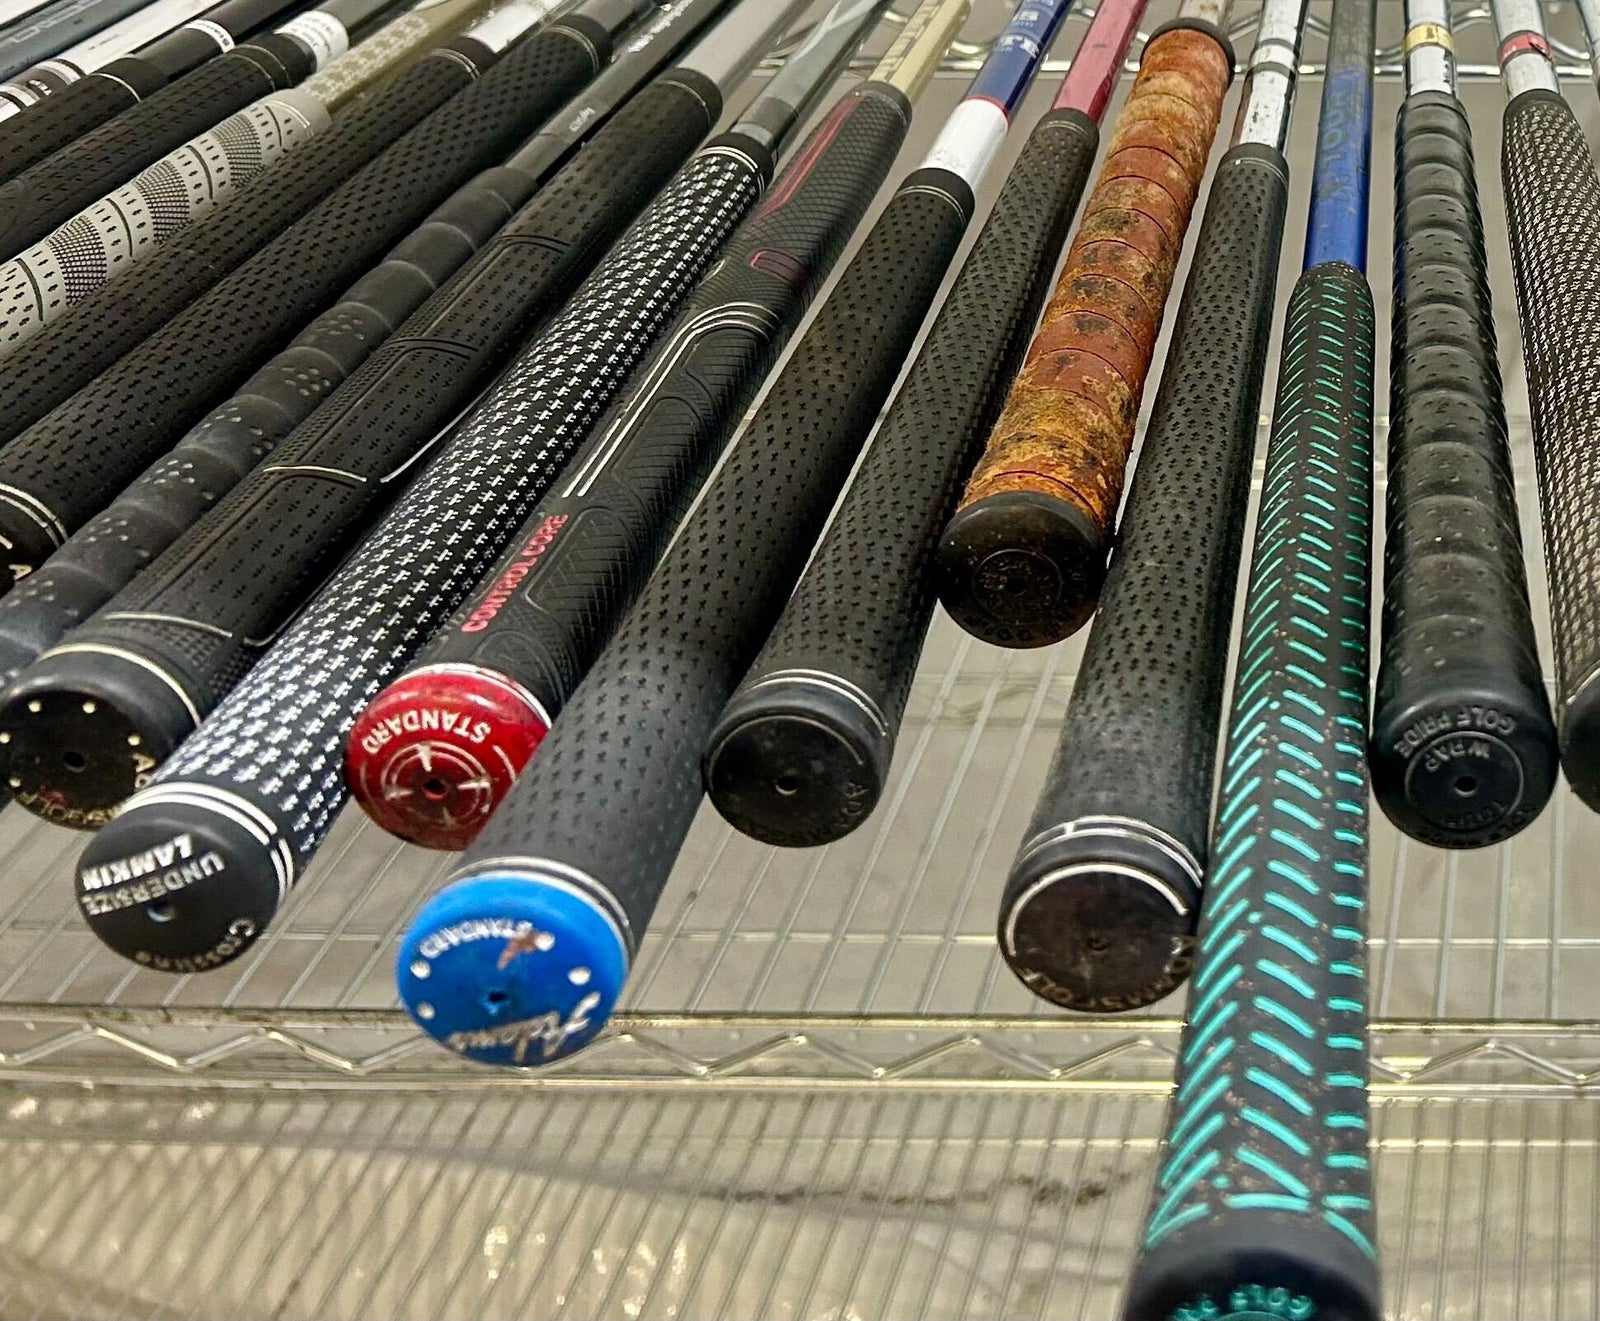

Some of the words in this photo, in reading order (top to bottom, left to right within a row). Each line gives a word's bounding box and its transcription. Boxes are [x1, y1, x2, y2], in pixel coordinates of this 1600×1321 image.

[461, 557, 537, 632] CONTROL
[520, 514, 568, 557] CORE
[361, 707, 492, 755] STANDARD
[1393, 710, 1452, 760] PRIDE
[1456, 706, 1518, 736] GOLF
[1424, 740, 1491, 773] WRAP
[81, 833, 194, 892] LAMKIN
[81, 851, 226, 916] UNDERSIZE
[419, 917, 533, 959] STANDARD
[444, 991, 602, 1062] Adams
